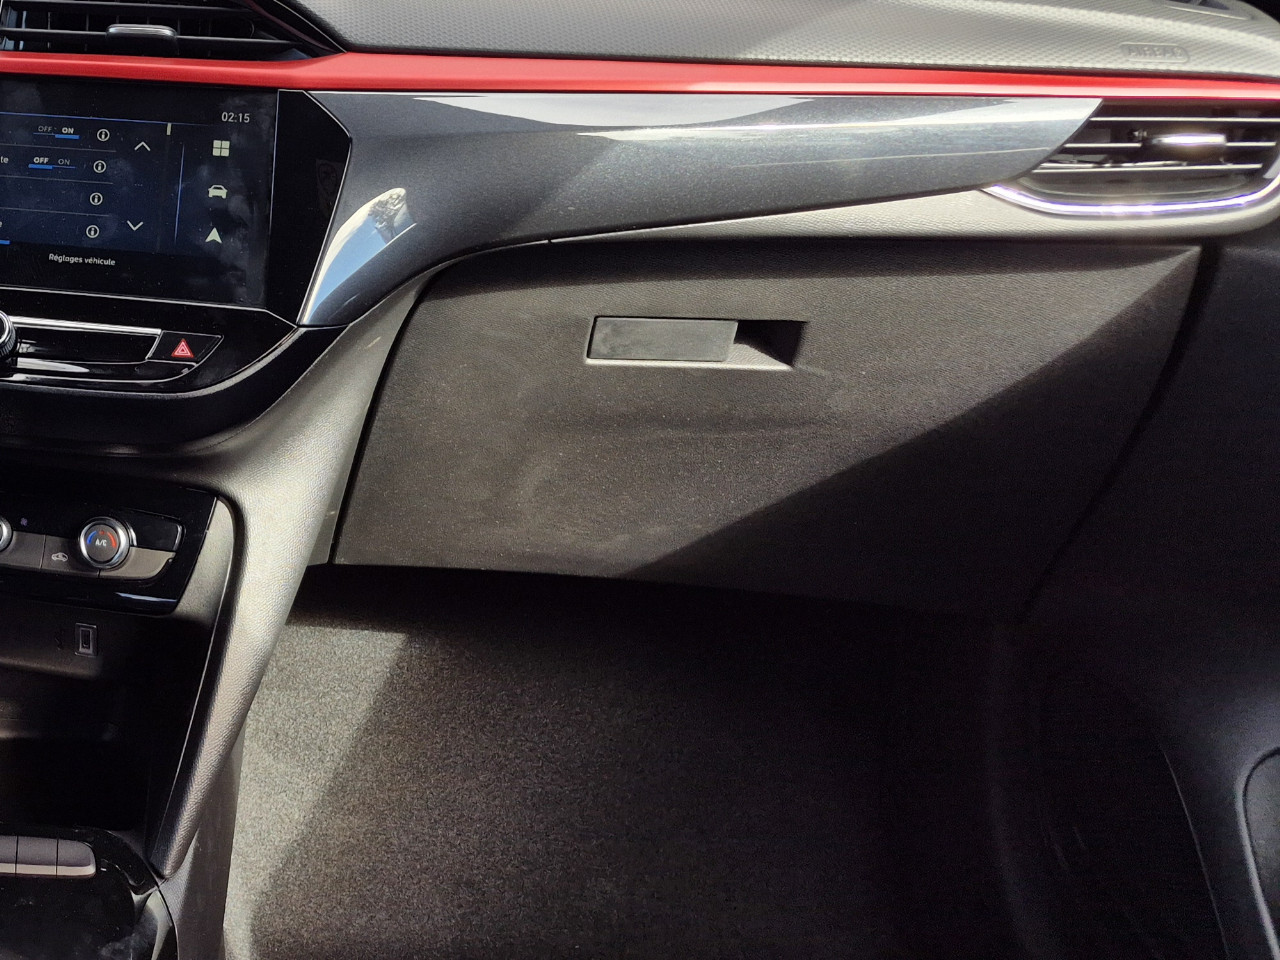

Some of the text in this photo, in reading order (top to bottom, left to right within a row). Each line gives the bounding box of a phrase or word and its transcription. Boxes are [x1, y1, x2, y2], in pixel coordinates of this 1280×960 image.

[221, 111, 250, 123] 02:15
[33, 156, 71, 166] OFF ON
[48, 253, 116, 266] Réglages véhicule
